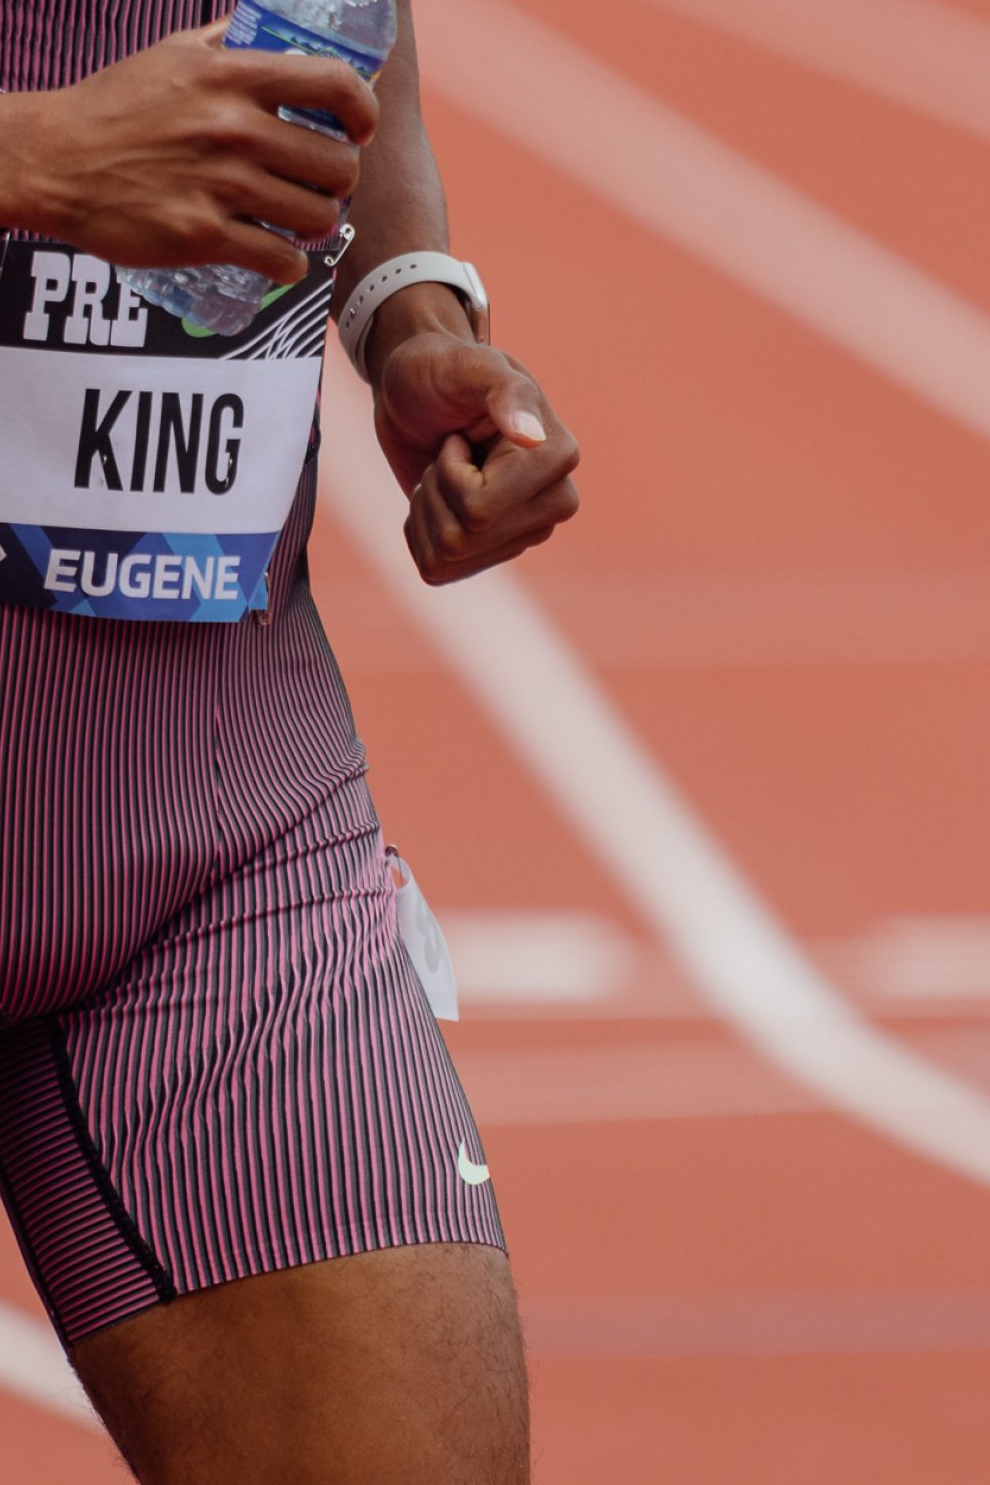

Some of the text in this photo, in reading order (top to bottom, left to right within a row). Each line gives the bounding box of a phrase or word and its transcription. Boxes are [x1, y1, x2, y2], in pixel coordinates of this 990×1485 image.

[23, 251, 148, 348] PRE
[74, 388, 244, 495] KING
[44, 548, 240, 600] EUGENE
